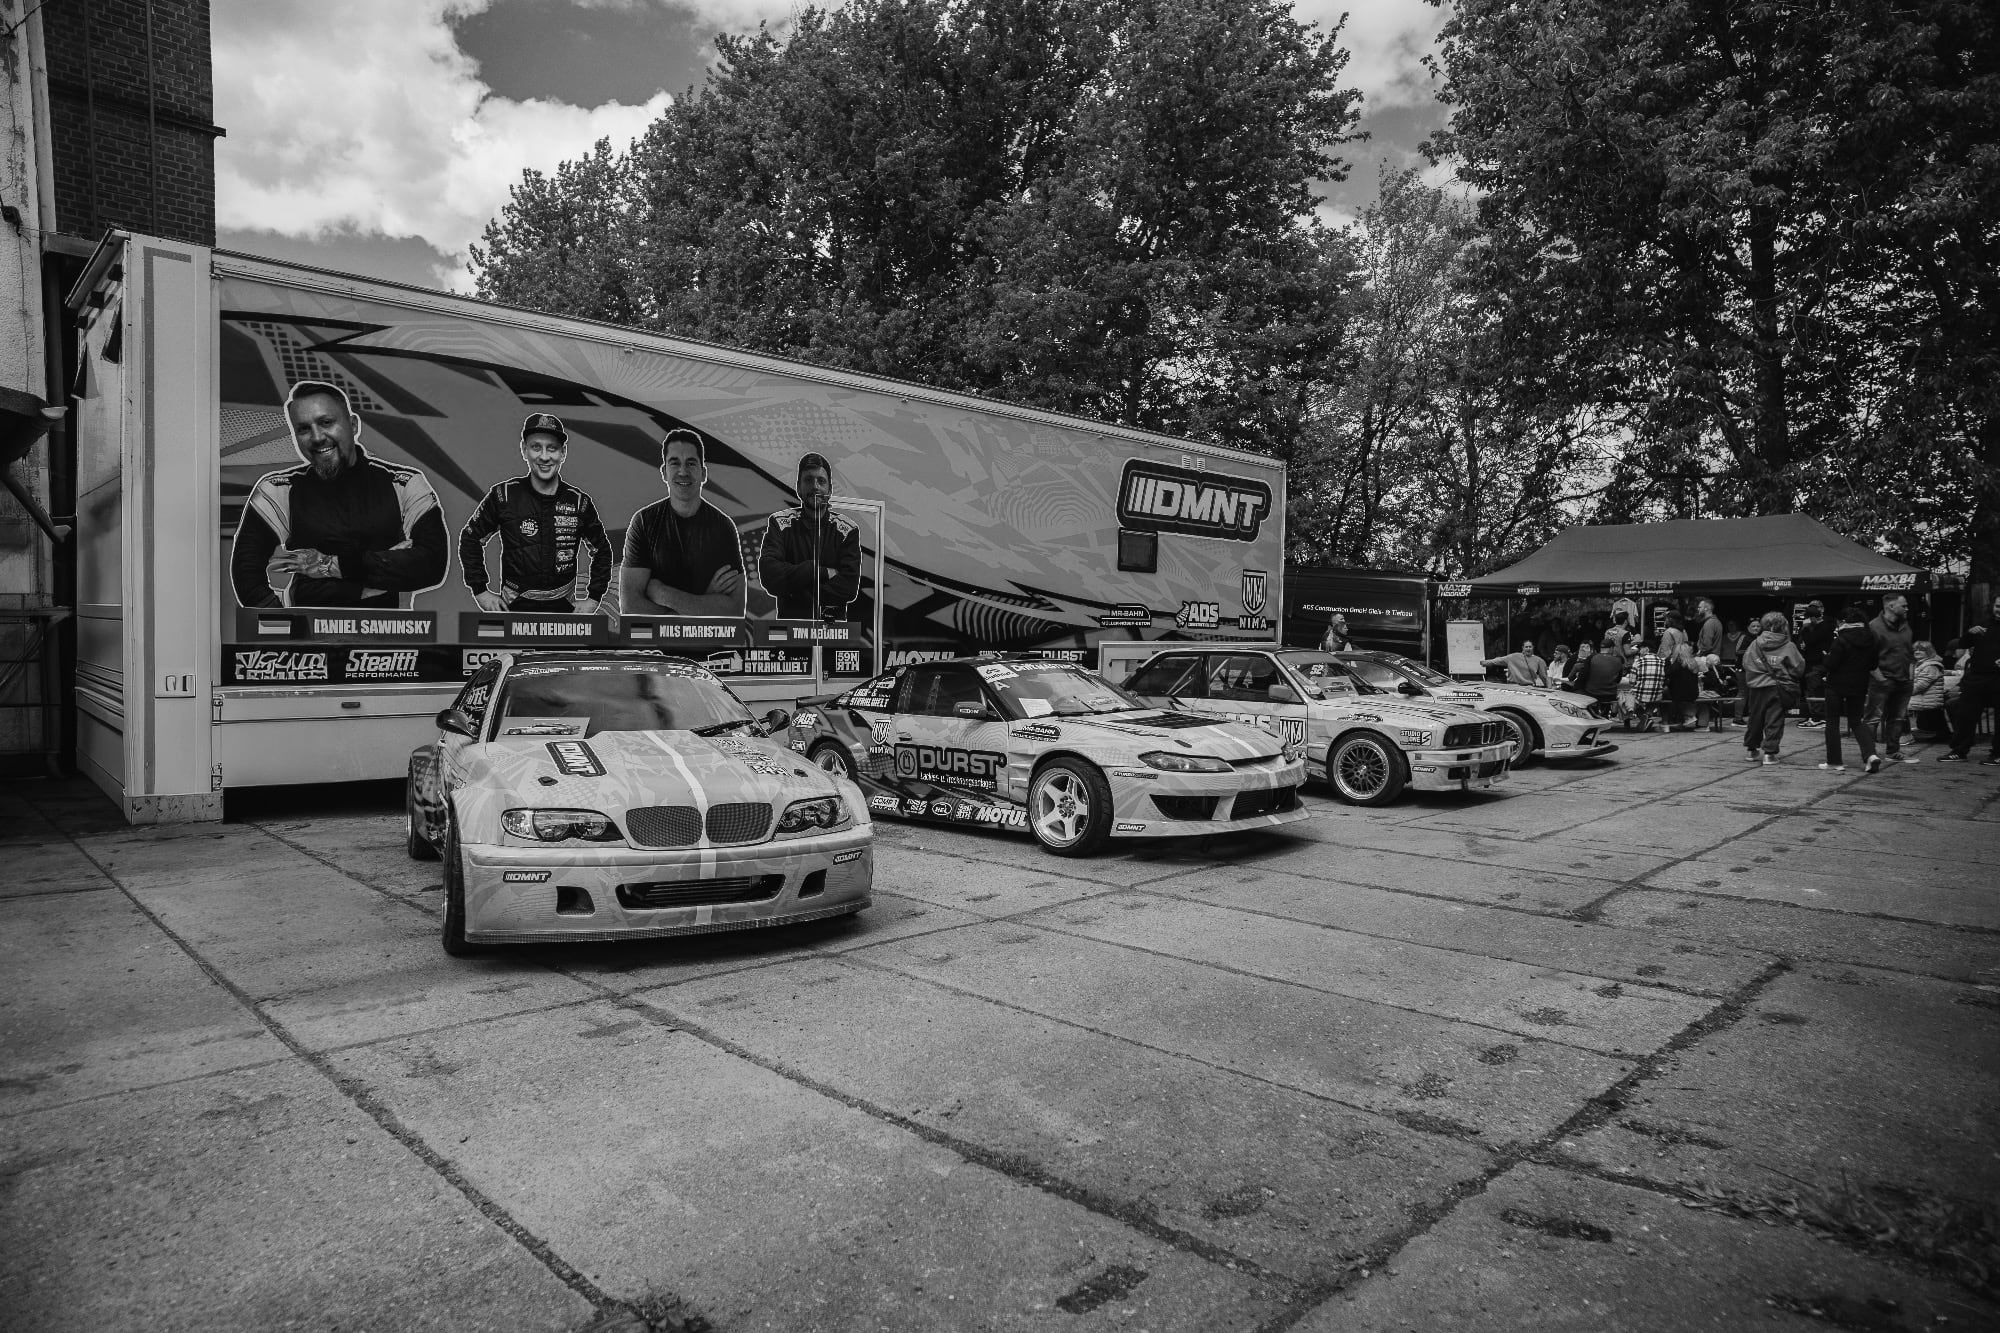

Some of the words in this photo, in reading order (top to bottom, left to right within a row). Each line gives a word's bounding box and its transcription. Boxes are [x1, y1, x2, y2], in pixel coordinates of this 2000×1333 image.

[1624, 581, 1675, 589] DURST
[1189, 603, 1219, 622] ADS
[360, 620, 431, 634] SAWINSKY
[511, 622, 538, 636] MAX
[539, 622, 592, 636] HEIDRICH
[1239, 616, 1267, 629] NIMA
[659, 625, 681, 638] NILS
[345, 650, 418, 672] Stealth
[777, 650, 786, 661] &
[919, 748, 999, 776] DURST
[976, 806, 1029, 827] MOTUL
